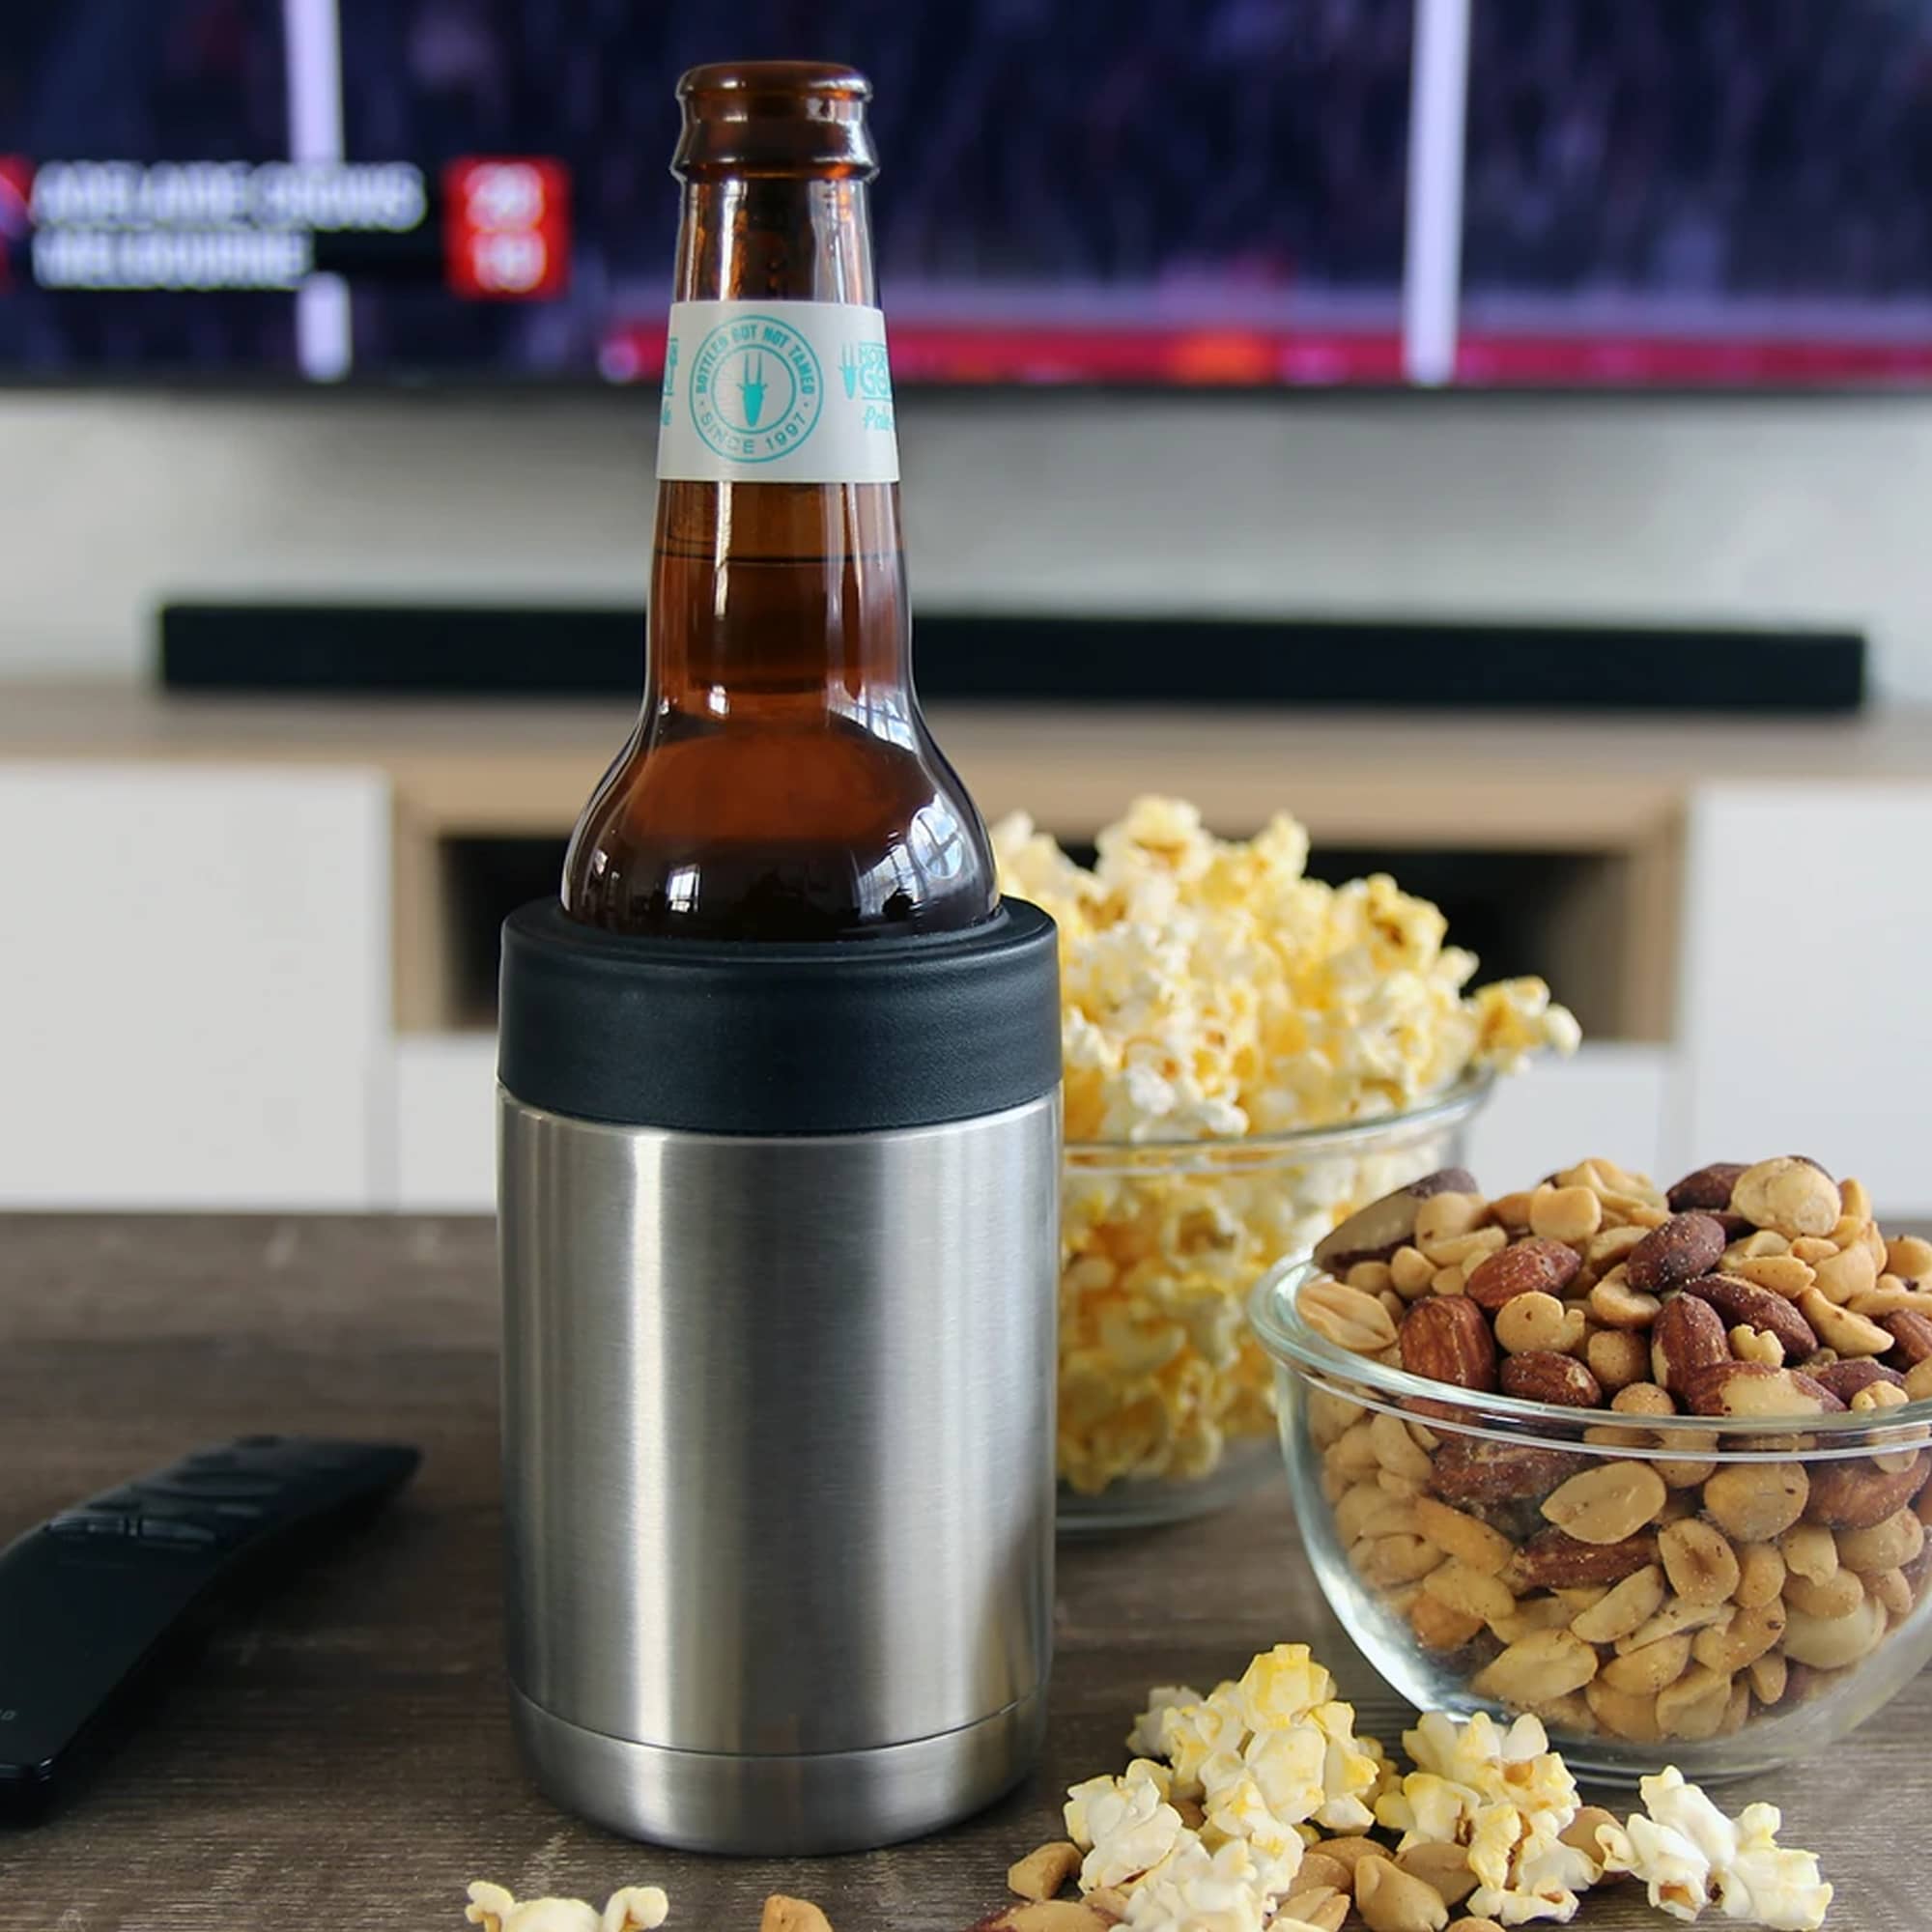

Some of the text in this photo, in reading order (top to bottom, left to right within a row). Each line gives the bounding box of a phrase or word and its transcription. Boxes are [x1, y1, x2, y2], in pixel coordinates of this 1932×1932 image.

[696, 335, 728, 394] BOTTLED
[731, 324, 757, 342] BUT
[763, 326, 790, 349] NOT
[788, 344, 815, 394] TAMED
[701, 412, 754, 454] SINCE
[765, 412, 805, 450] 1997
